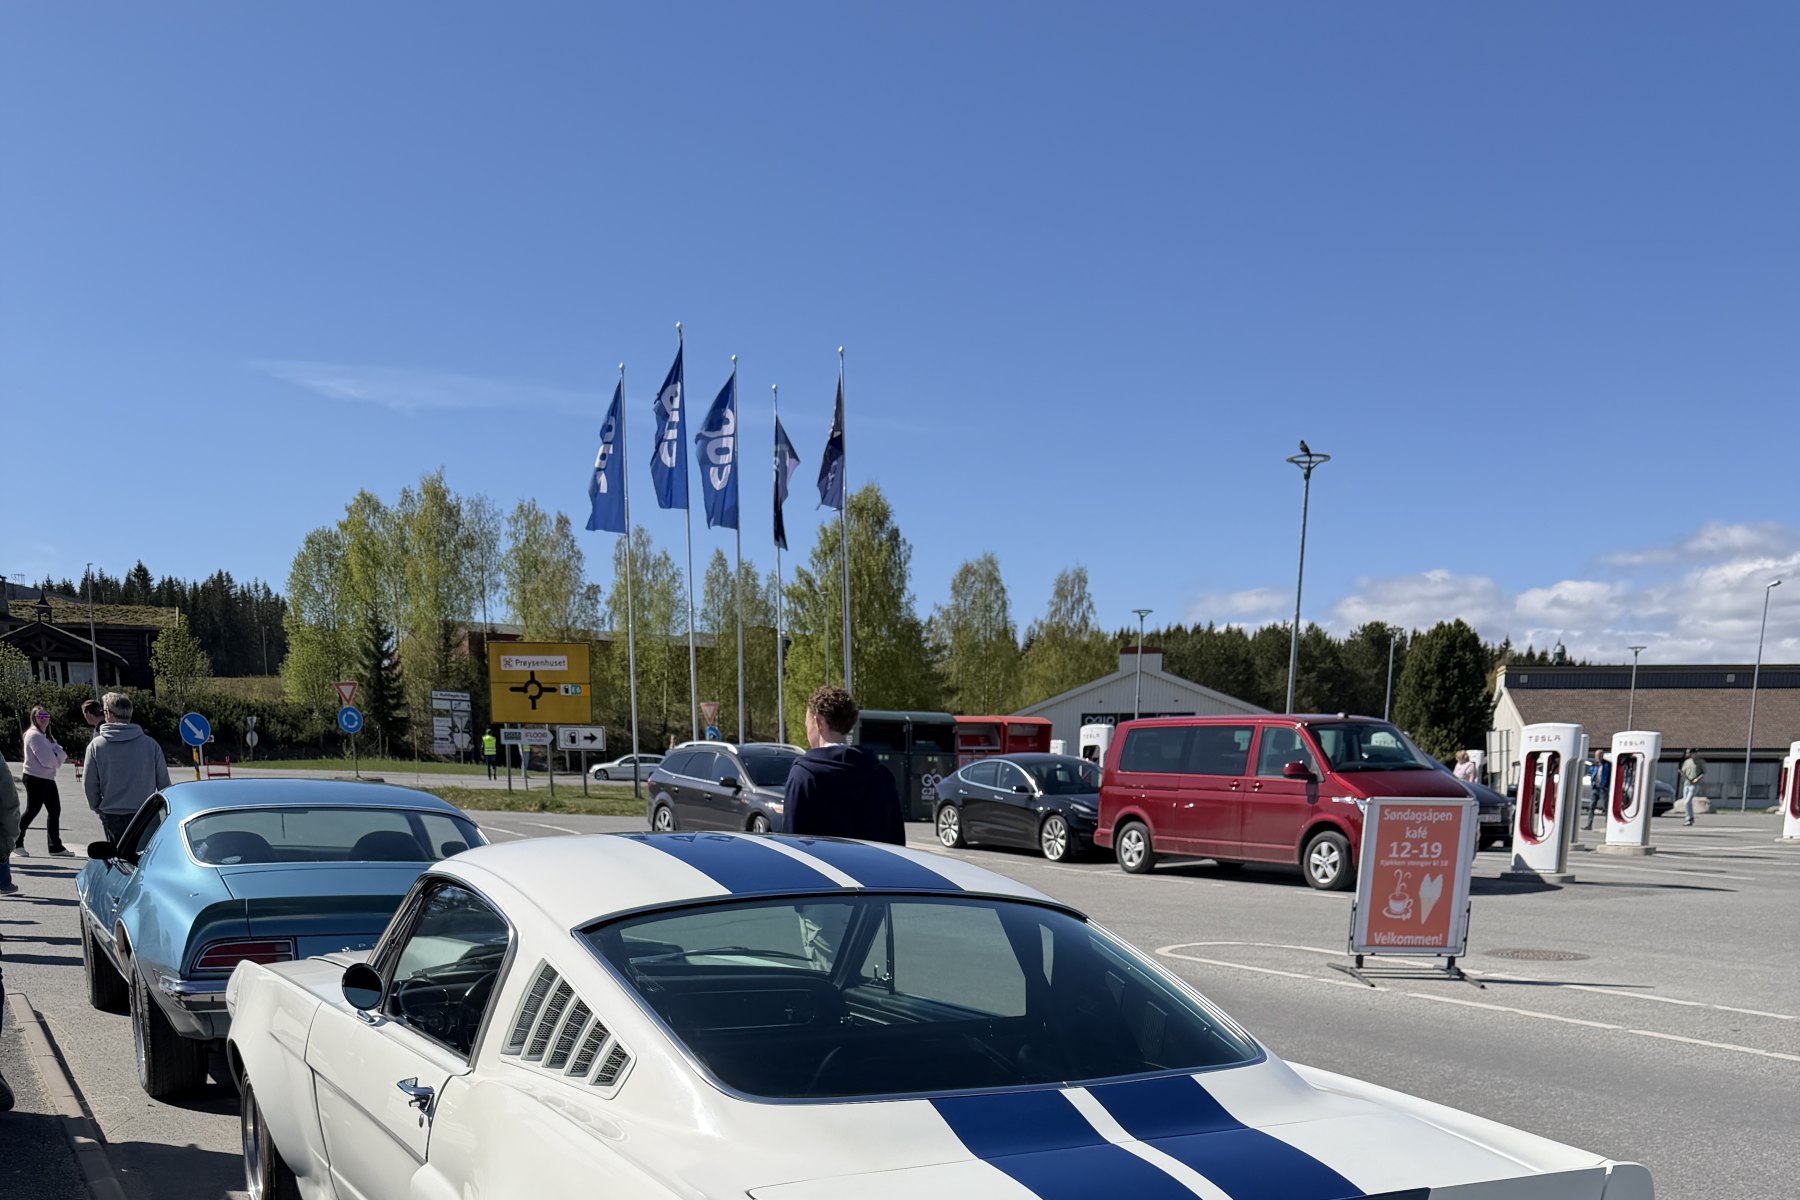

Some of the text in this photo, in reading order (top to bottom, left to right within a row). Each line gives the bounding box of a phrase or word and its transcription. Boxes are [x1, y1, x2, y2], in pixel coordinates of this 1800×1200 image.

[1528, 735, 1561, 743] TESLA
[1384, 808, 1453, 824] Søndagsåpen
[1405, 826, 1428, 839] kafé
[1388, 841, 1442, 858] 12-19
[1374, 932, 1443, 946] Velkommen!
